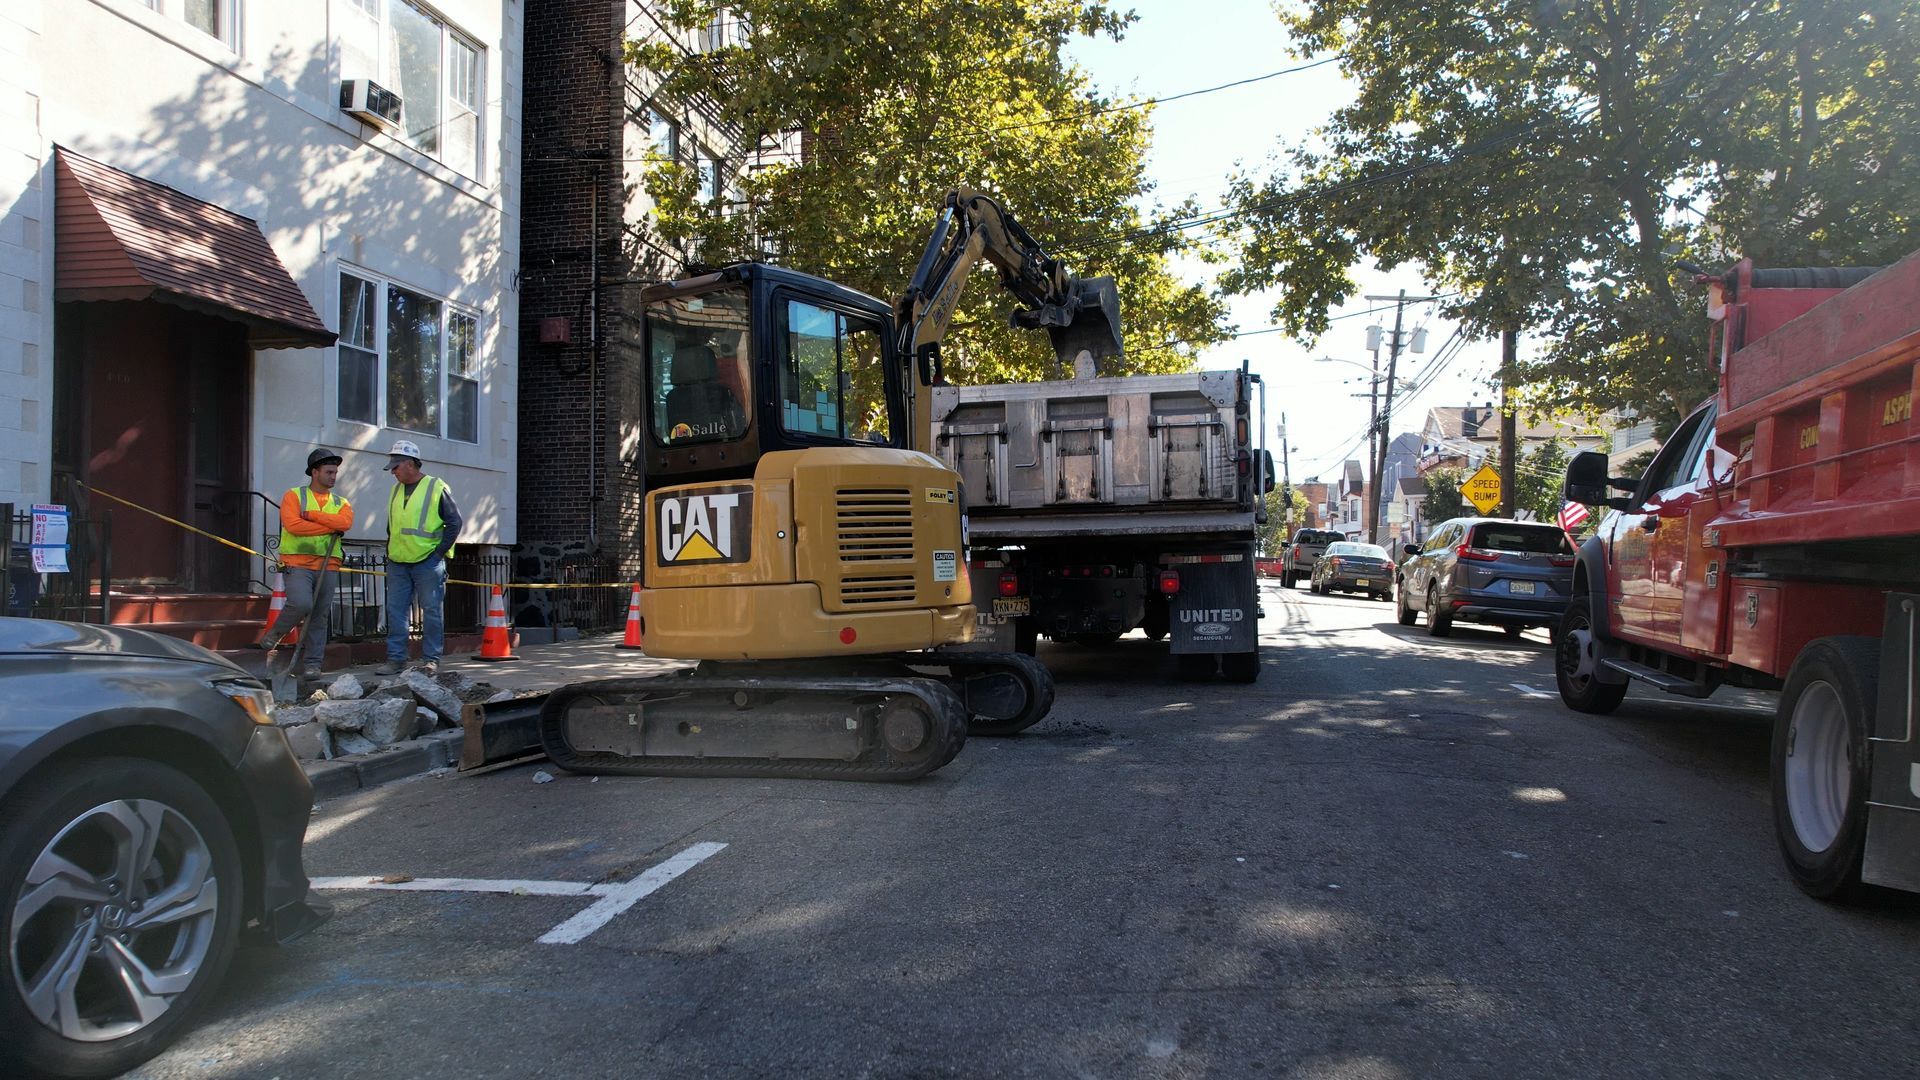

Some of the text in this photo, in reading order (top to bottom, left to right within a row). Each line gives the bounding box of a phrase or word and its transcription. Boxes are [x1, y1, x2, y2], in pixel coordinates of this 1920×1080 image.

[1473, 480, 1500, 489] SPEED
[1474, 492, 1498, 501] BUMP
[36, 514, 47, 522] NO
[661, 493, 739, 562] CAT
[1180, 609, 1243, 622] UNITED
